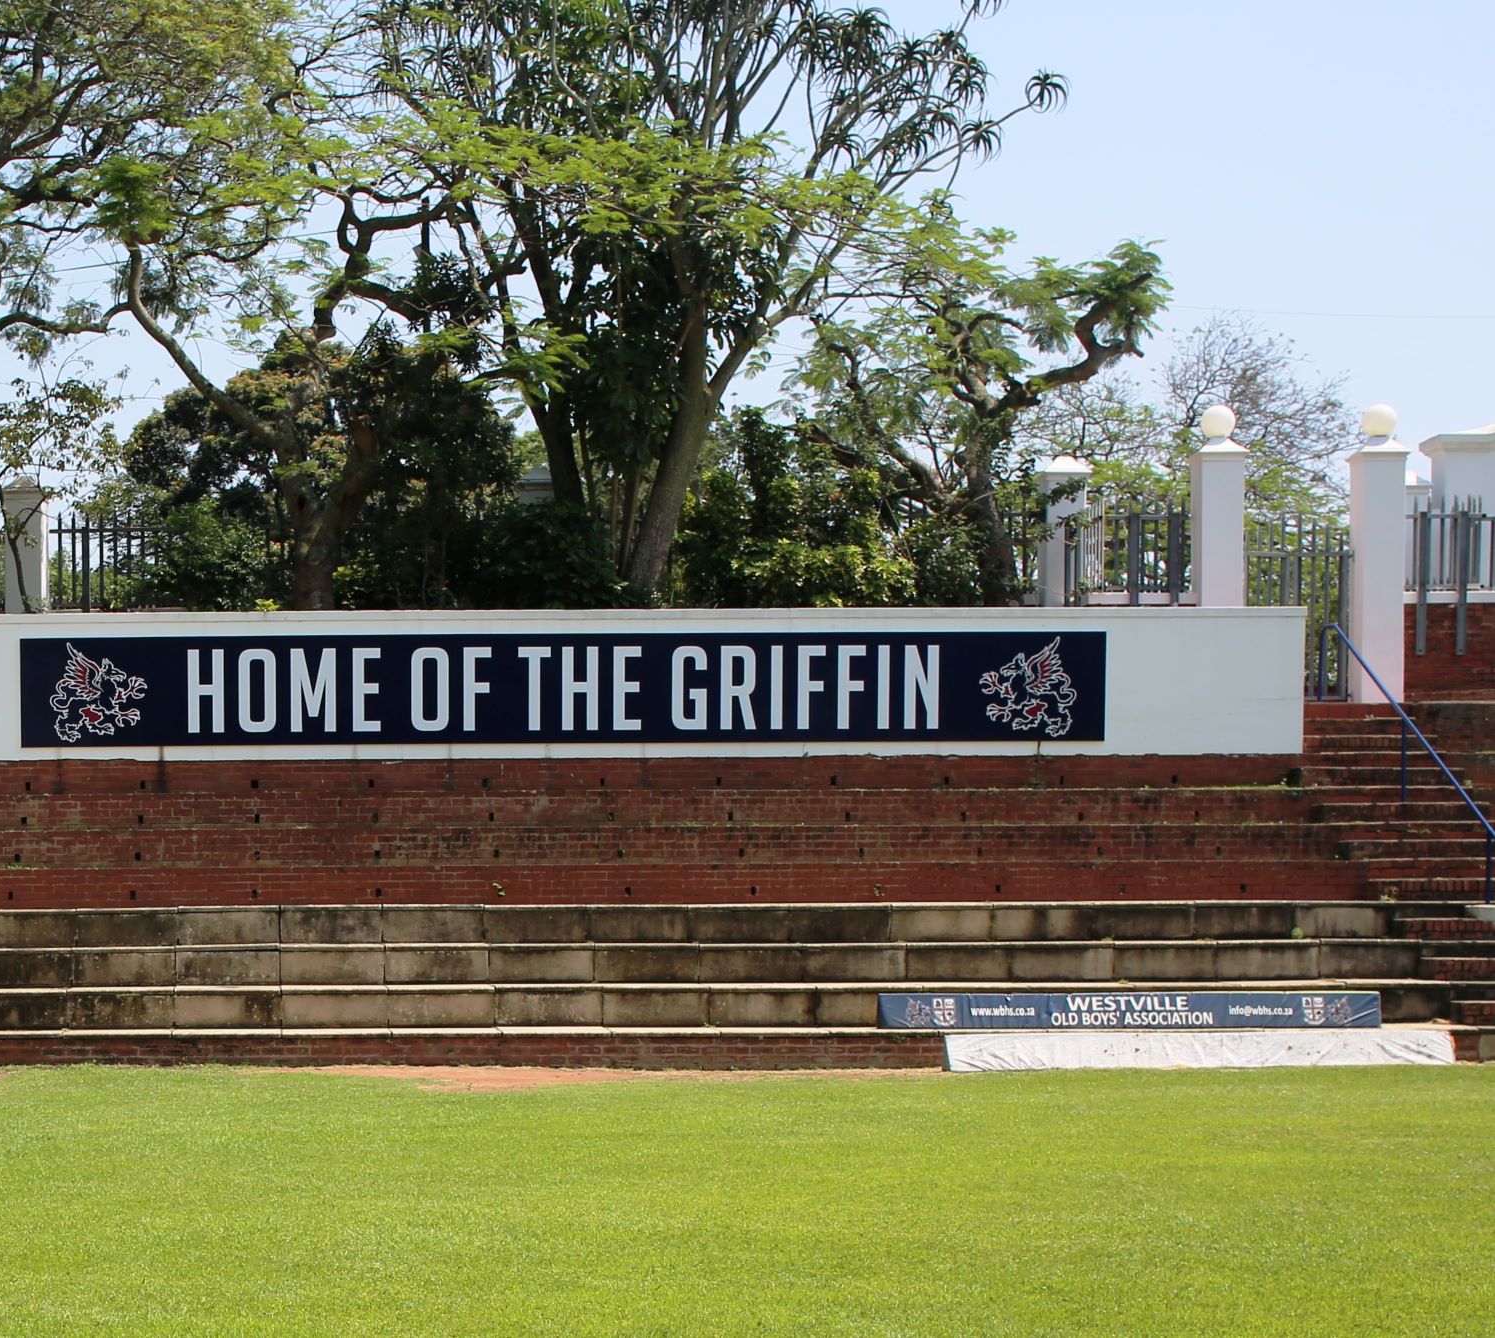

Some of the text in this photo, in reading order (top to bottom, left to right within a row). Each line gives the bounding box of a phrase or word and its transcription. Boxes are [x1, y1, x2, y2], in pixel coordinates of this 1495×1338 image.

[187, 645, 940, 733] HOME OF THE GRIFFIN
[970, 1005, 1035, 1017] www.wbhs.co.za
[1066, 996, 1189, 1011] WESTVILLE
[1228, 1005, 1293, 1017] info@wbhs.co.za
[1051, 1011, 1214, 1026] OLD BOYS' ASSOCIATION
